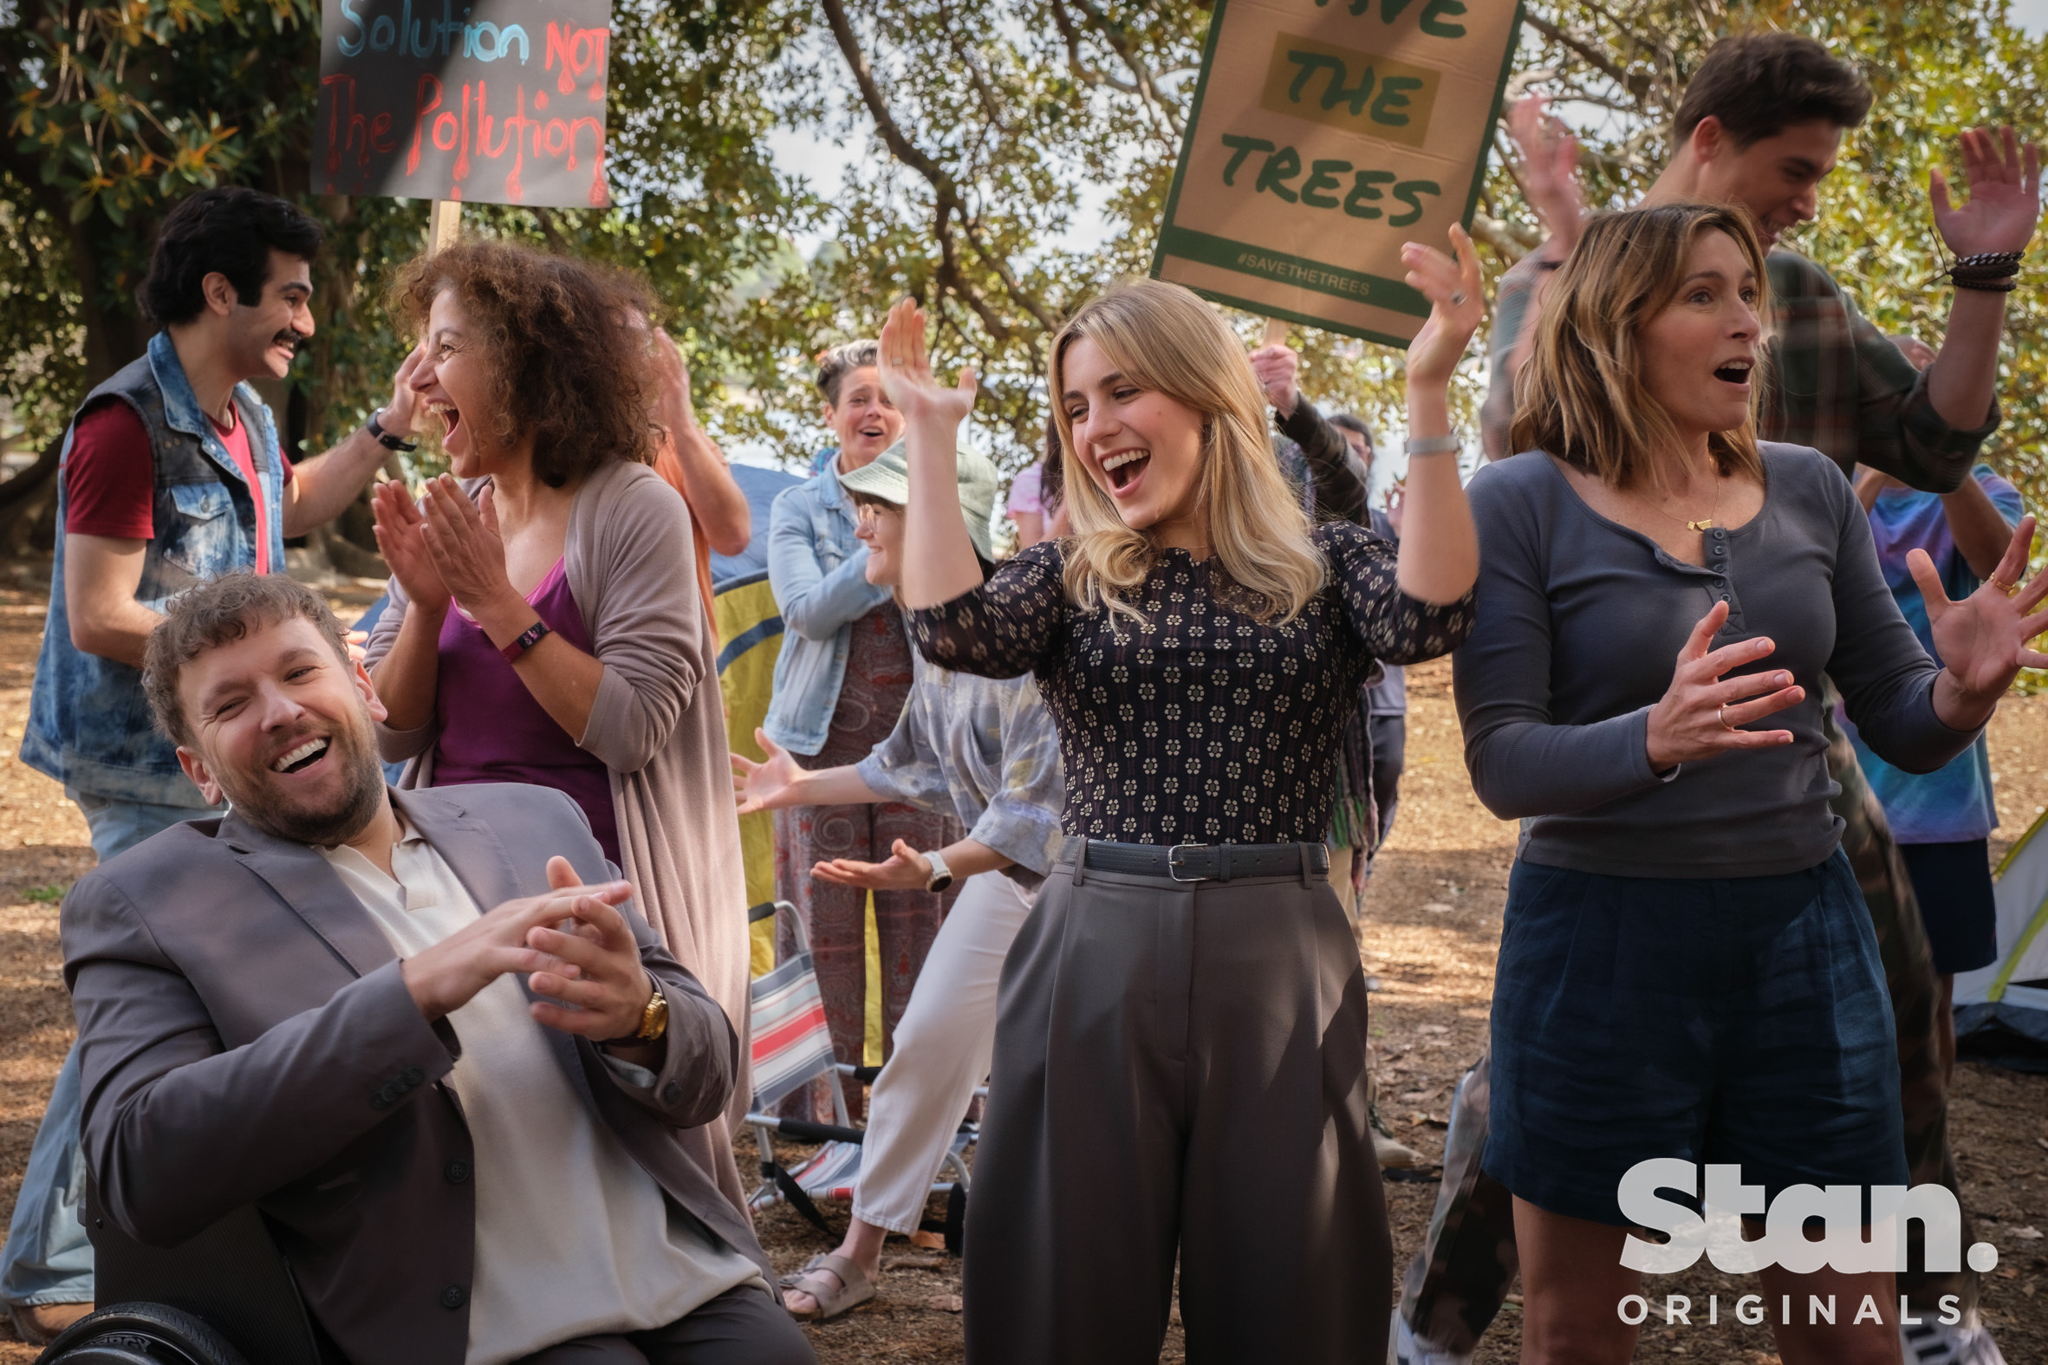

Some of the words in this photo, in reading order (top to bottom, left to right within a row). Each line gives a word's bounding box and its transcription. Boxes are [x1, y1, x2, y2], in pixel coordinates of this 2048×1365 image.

[337, 0, 529, 64] Solution
[545, 20, 609, 84] NOT
[321, 73, 396, 166] The
[405, 73, 607, 184] Pollution
[1288, 49, 1423, 126] THE
[1221, 133, 1441, 227] TREES
[1236, 252, 1371, 296] #SAVETHETREES
